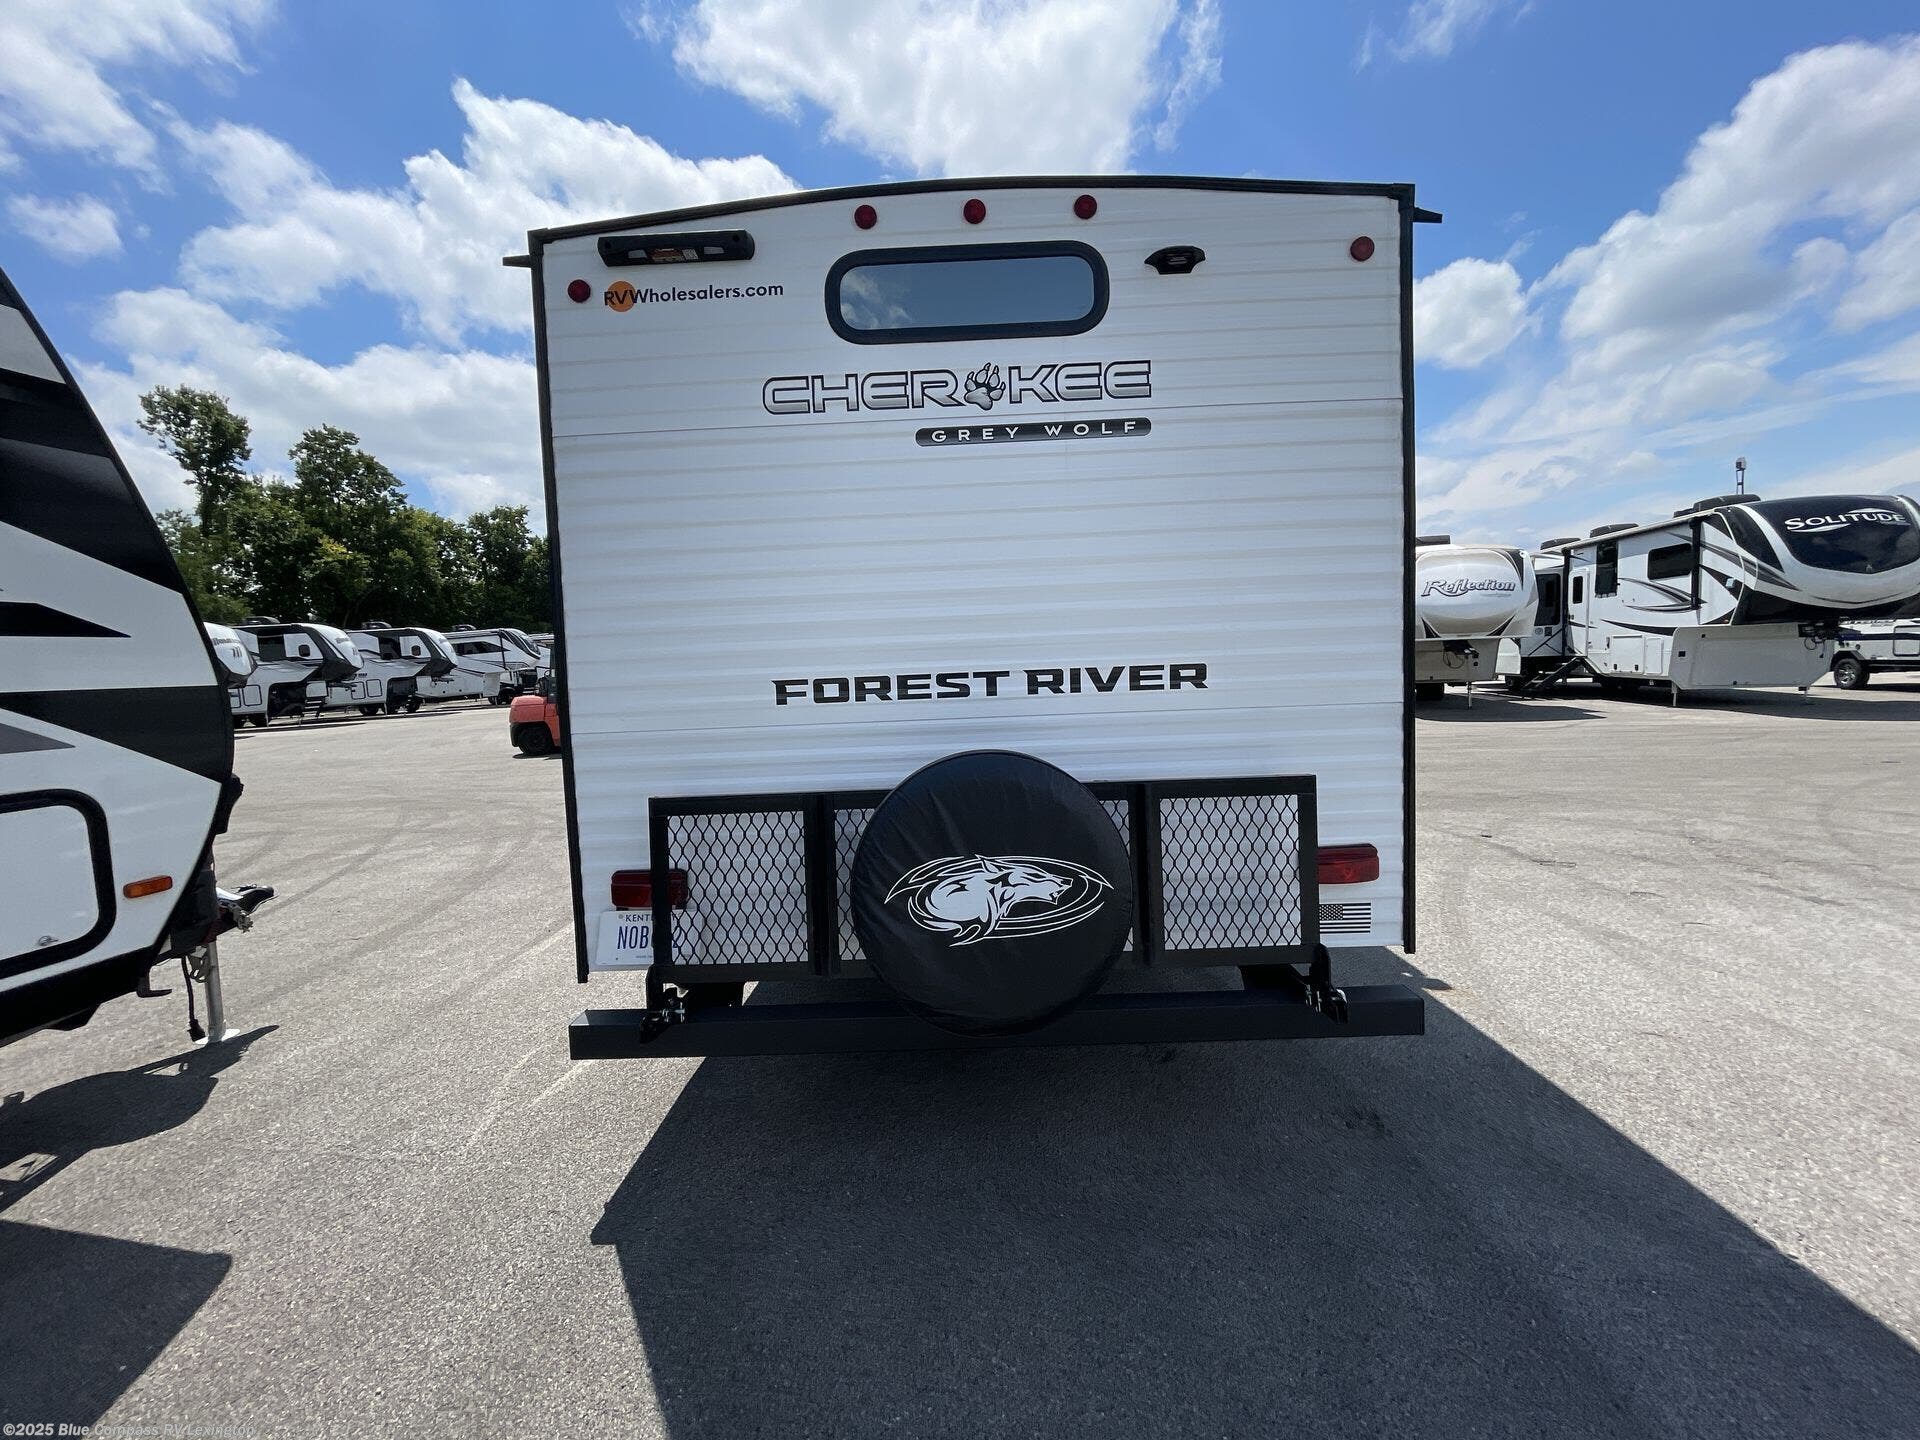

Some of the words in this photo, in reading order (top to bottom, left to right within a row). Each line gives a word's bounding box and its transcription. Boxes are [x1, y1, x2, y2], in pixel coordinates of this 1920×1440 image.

[604, 284, 784, 306] RVWholesalers.com
[931, 427, 1019, 442] GREY
[1044, 421, 1136, 437] WOLF
[1784, 512, 1905, 530] SOLITUDE
[1421, 579, 1516, 597] Reflection
[771, 671, 1010, 705] FOREST
[1023, 663, 1208, 695] RIVER
